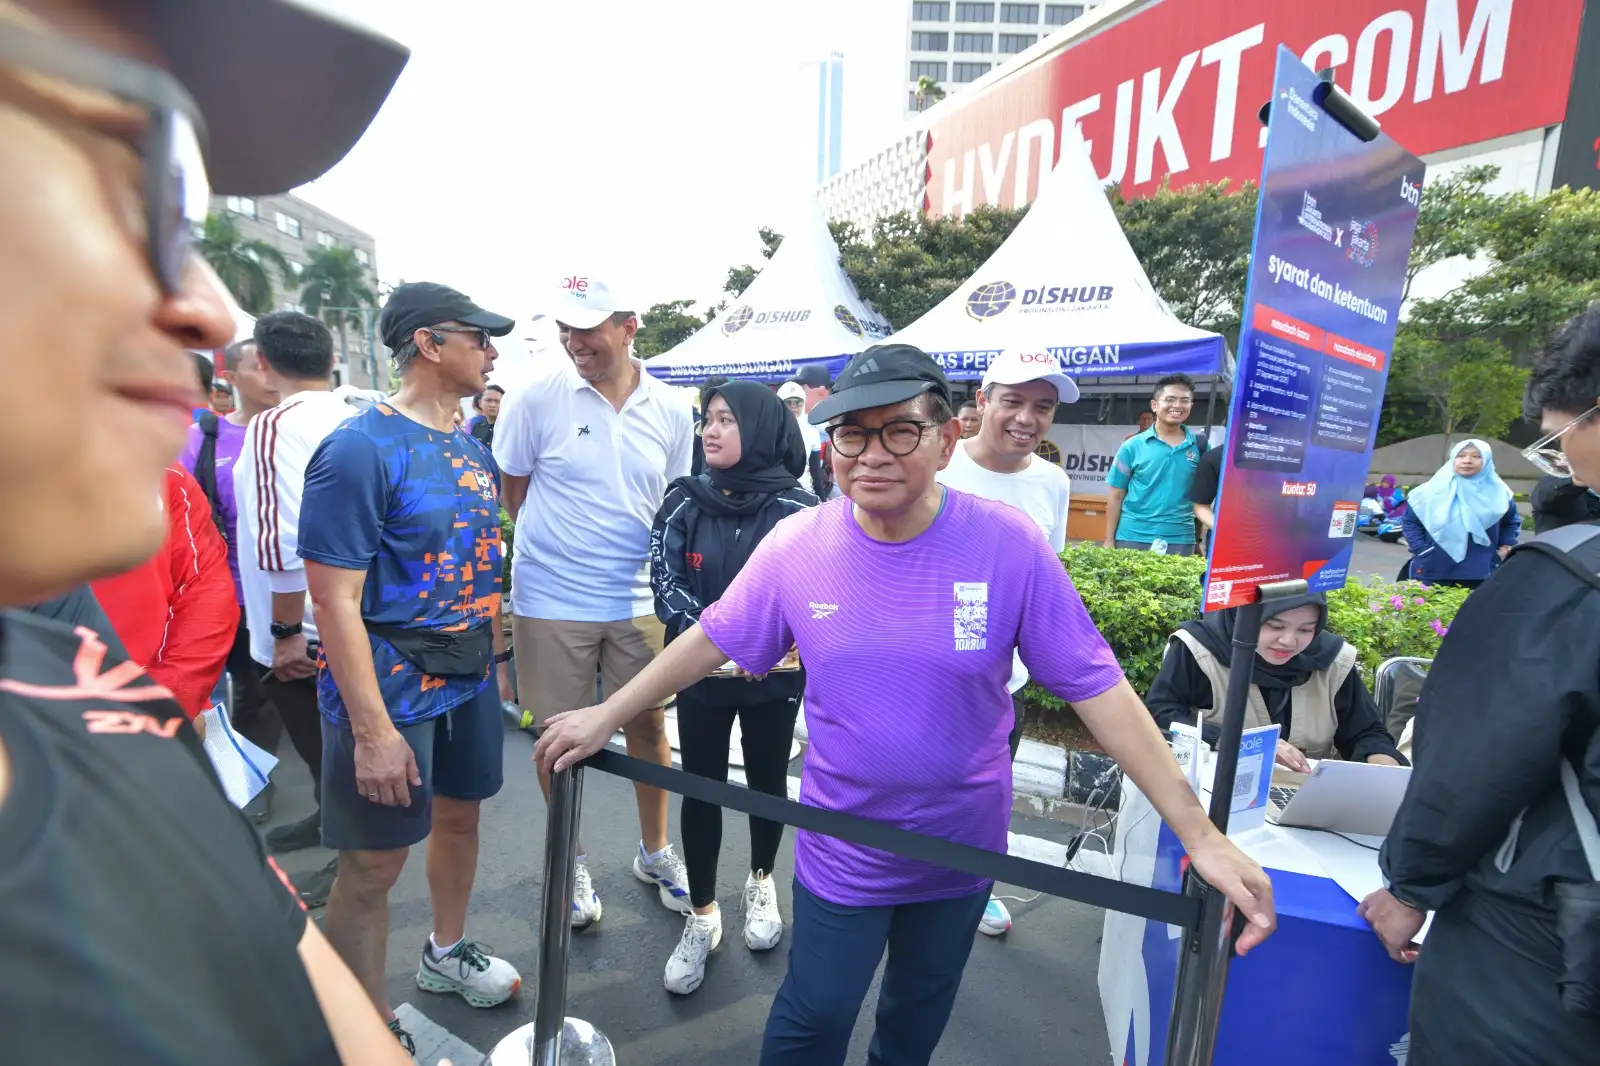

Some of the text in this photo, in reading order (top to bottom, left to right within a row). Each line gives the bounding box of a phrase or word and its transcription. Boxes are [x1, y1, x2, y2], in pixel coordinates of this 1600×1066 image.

[1400, 175, 1421, 206] btn
[1021, 285, 1114, 305] DISHUB
[1268, 254, 1310, 290] syarat
[1310, 273, 1333, 301] dan
[1333, 283, 1388, 325] ketentuan
[755, 309, 812, 324] DISHUB
[1282, 480, 1316, 496] kuota: 50
[809, 601, 838, 611] Reebok
